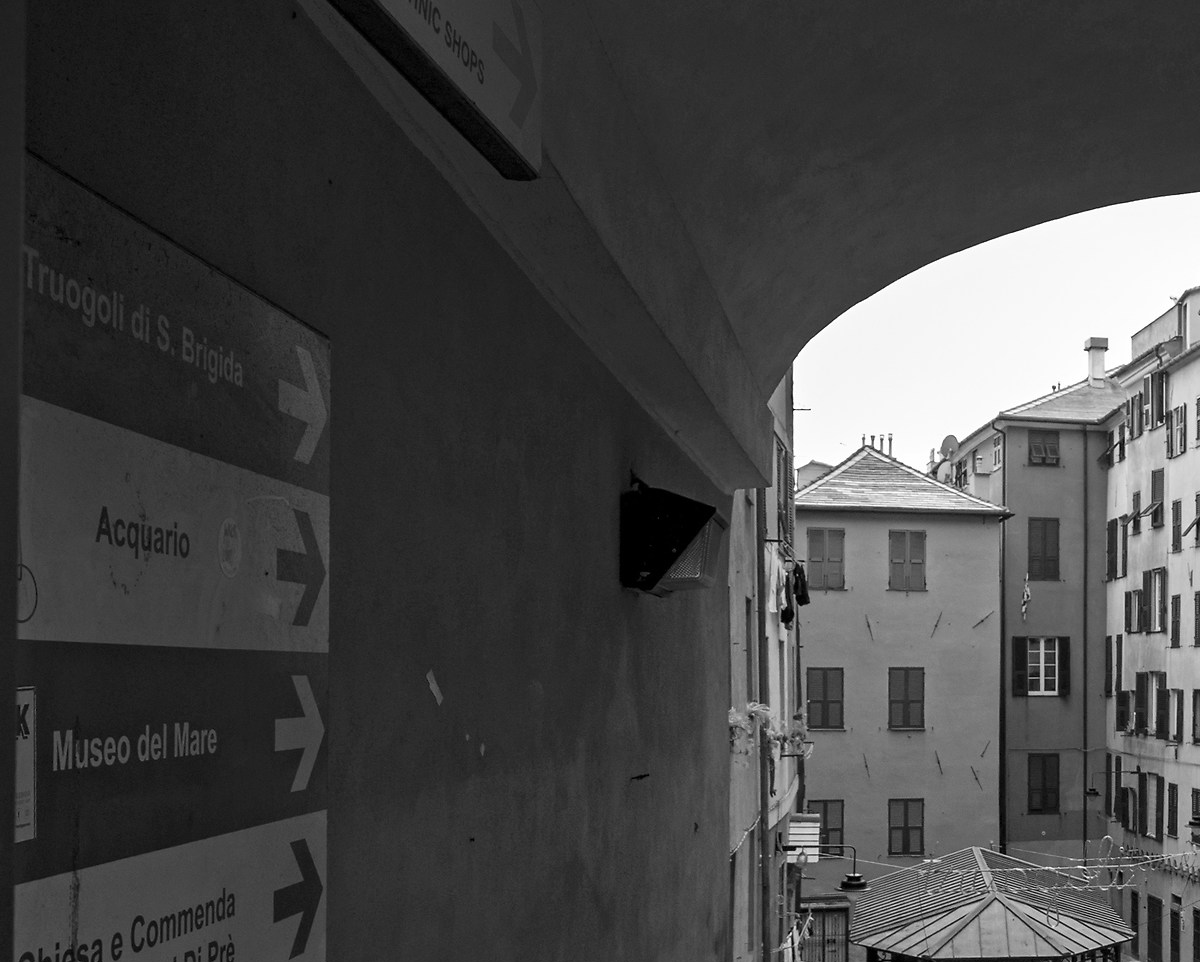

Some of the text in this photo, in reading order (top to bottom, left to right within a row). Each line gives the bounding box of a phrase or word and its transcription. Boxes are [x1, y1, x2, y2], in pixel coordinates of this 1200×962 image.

[445, 20, 484, 84] SHOPS
[23, 245, 243, 387] Truogoli di S. Brigida
[96, 505, 190, 559] Acquario
[53, 722, 217, 771] Museo del Mare
[110, 932, 123, 961] e
[131, 888, 236, 952] Commenda
